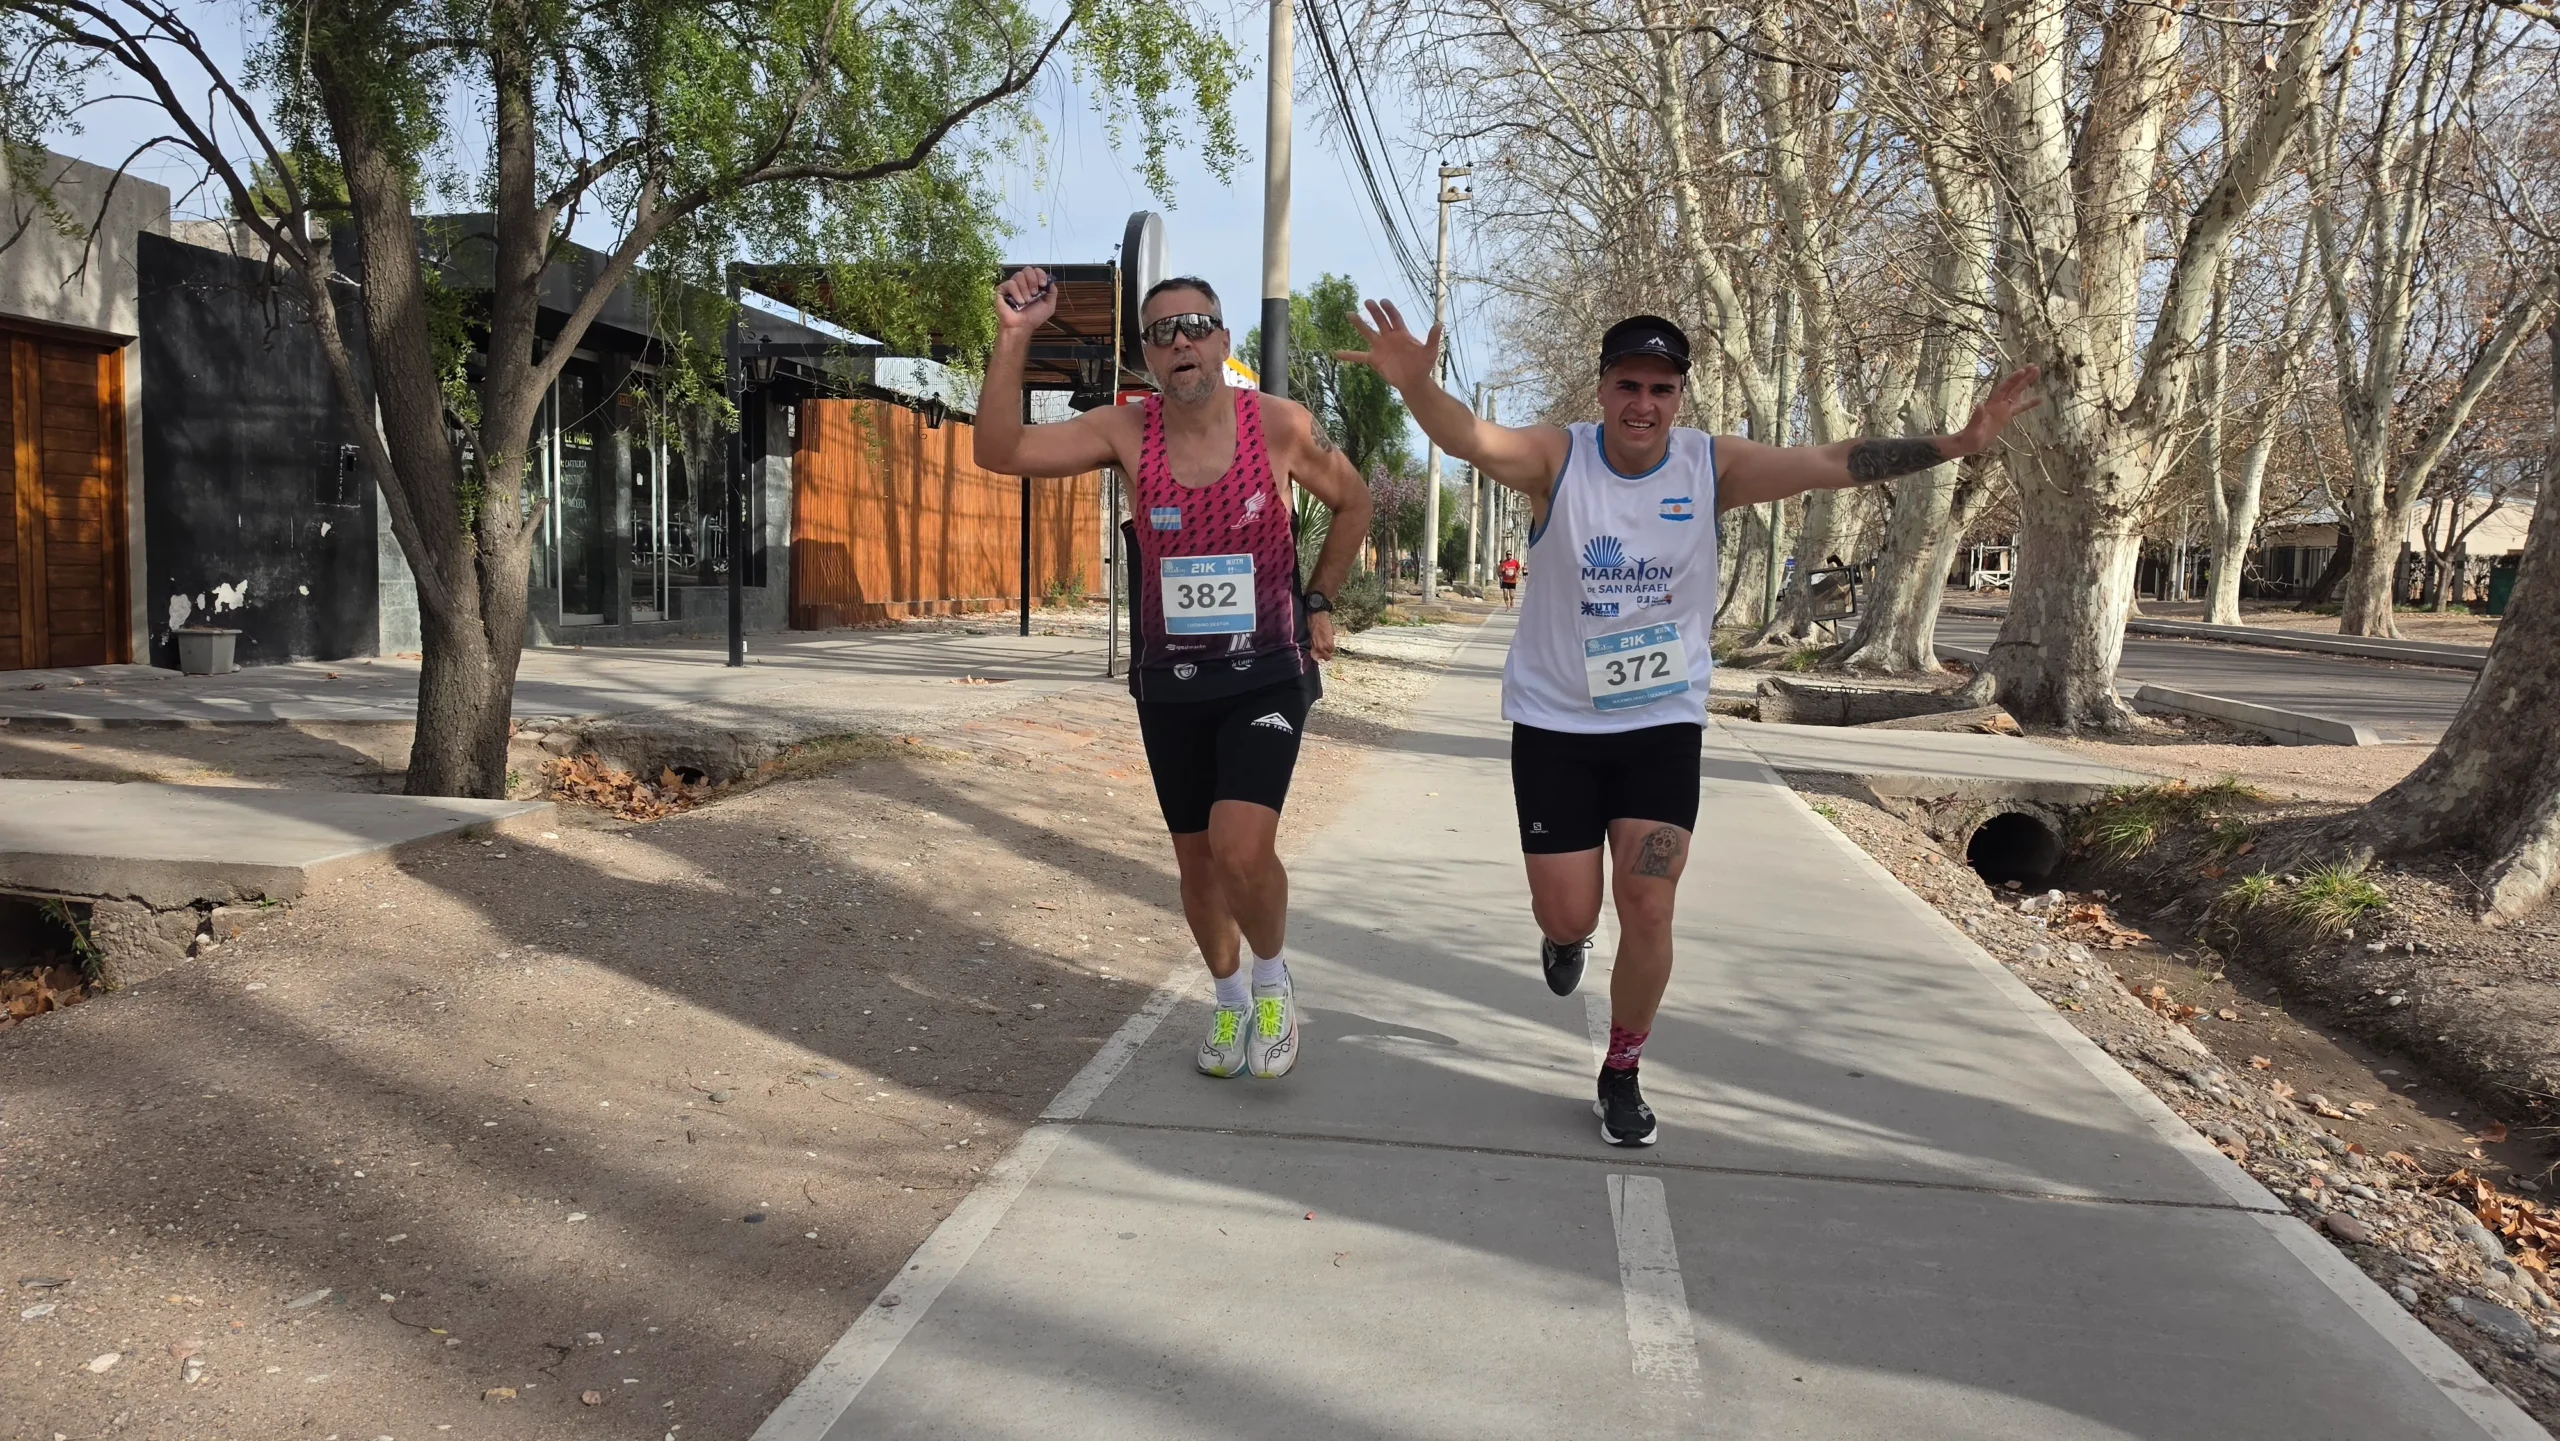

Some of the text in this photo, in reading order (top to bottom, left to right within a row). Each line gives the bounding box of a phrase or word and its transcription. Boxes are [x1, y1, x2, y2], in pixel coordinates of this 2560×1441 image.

[1191, 562, 1216, 574] 21K
[1598, 584, 1623, 594] SAN
[1625, 583, 1670, 594] RAFAEL
[1177, 582, 1237, 609] 382
[1594, 602, 1619, 610] UTN
[1620, 634, 1645, 649] 21K
[1605, 651, 1671, 686] 372
